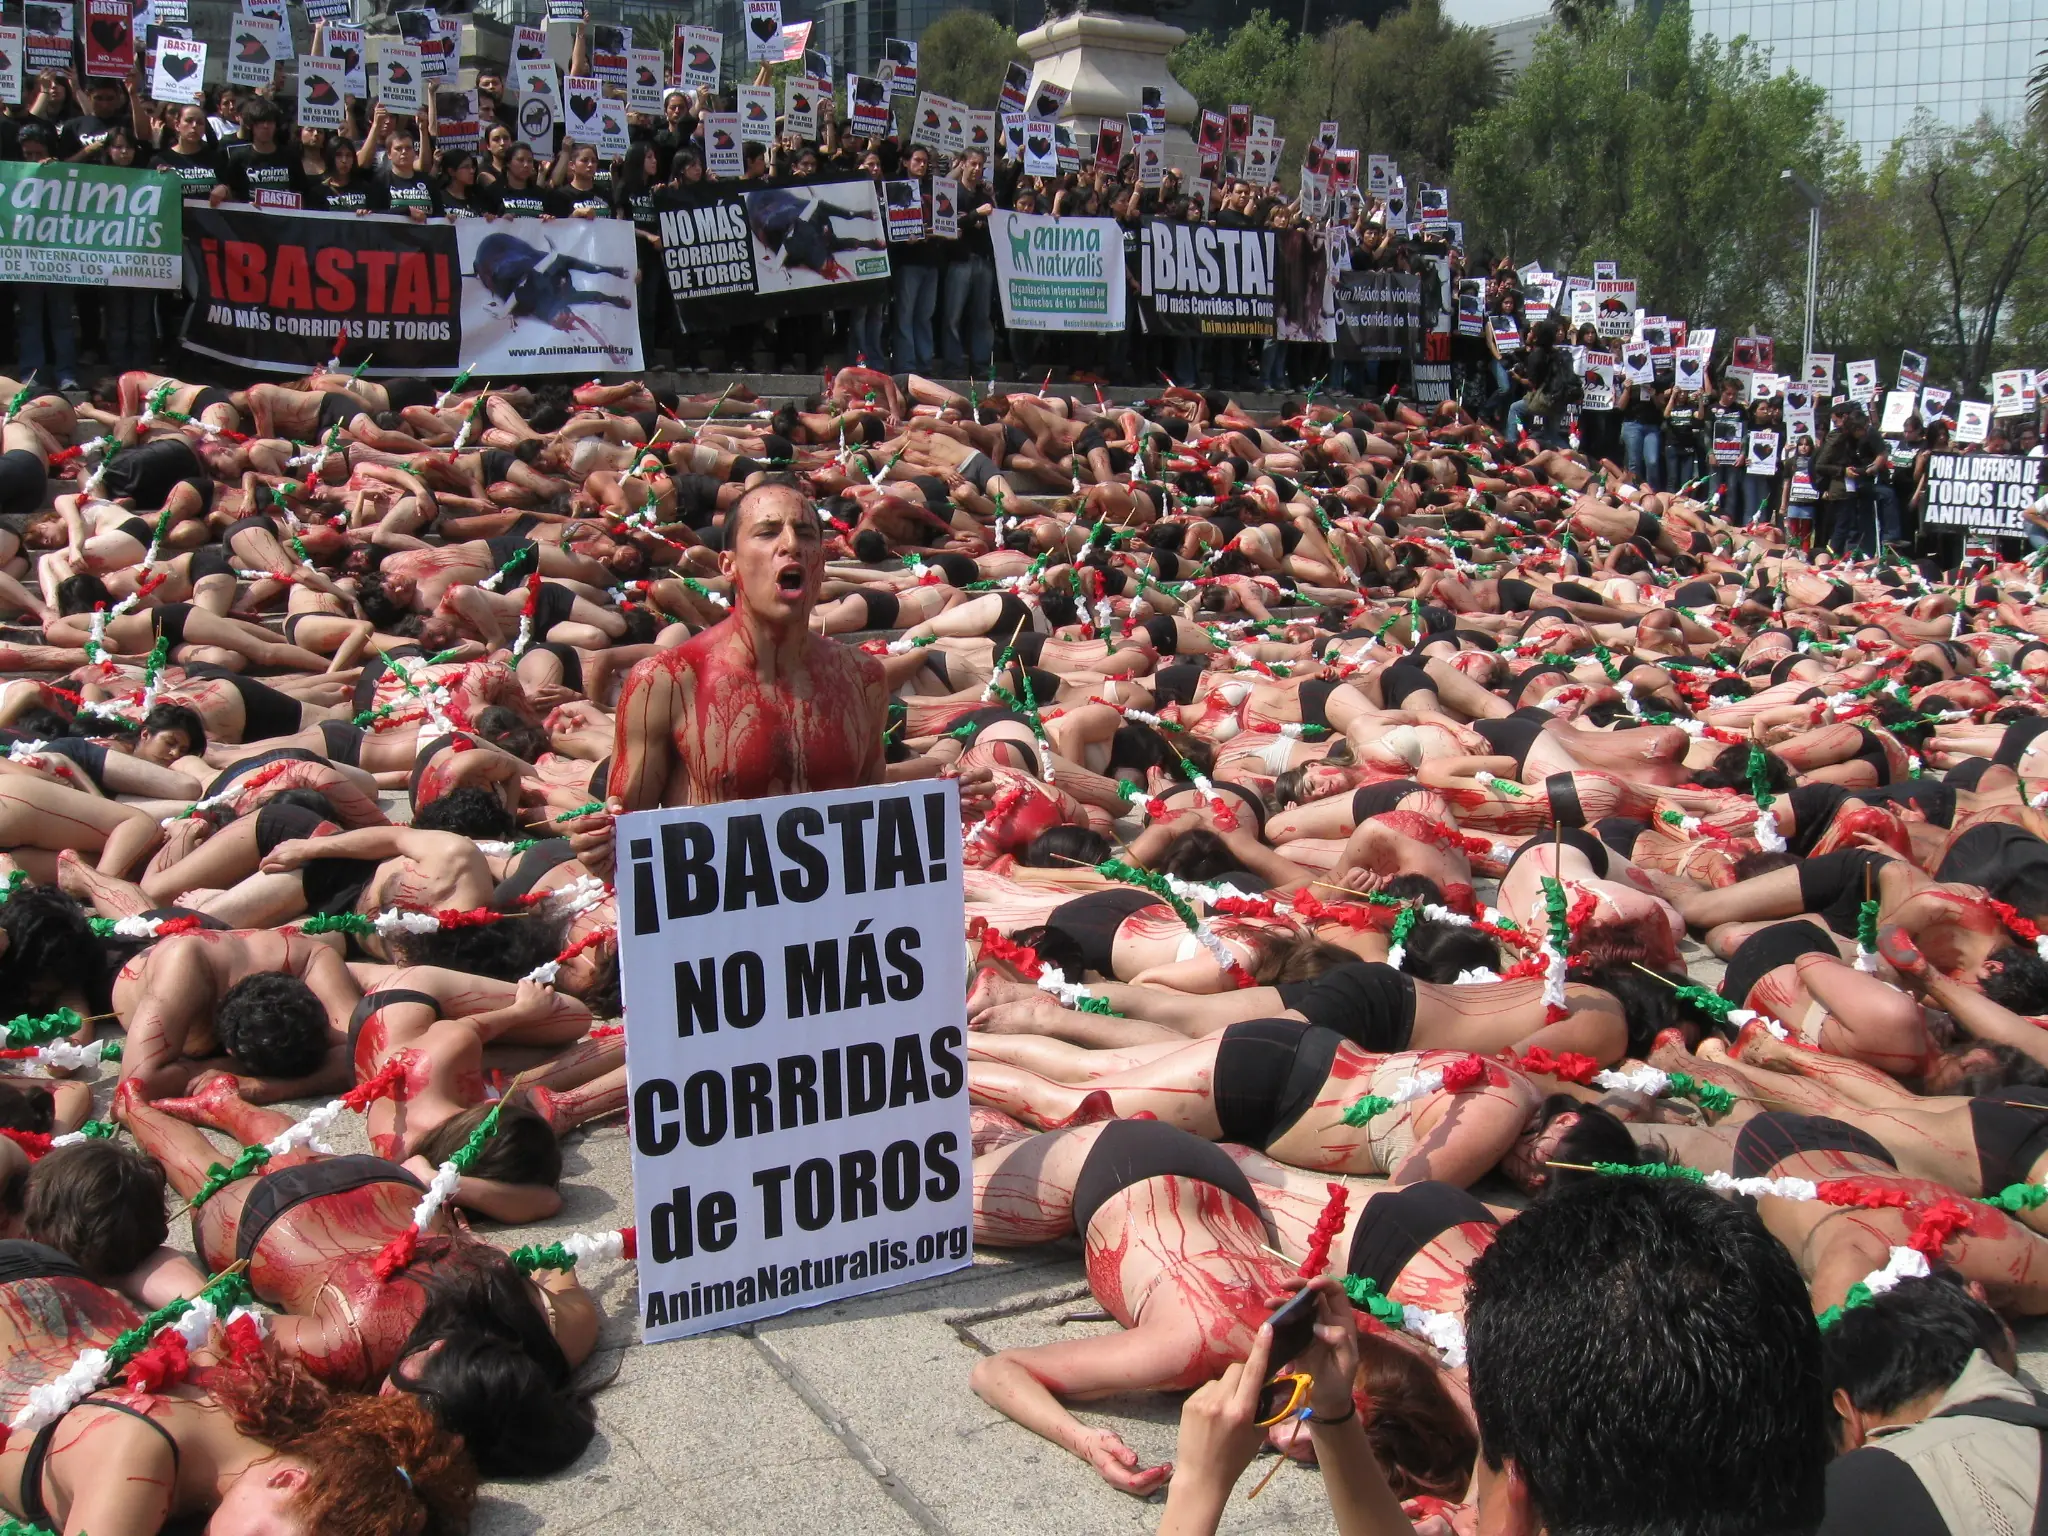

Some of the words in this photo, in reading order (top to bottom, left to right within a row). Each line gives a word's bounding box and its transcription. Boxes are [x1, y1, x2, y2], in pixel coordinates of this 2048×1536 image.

[90, 2, 127, 16] ¡BASTA!
[309, 6, 347, 18] ABOLICIÓN
[748, 1, 777, 14] ¡BASTA!
[244, 21, 274, 30] TORTURA
[329, 30, 359, 43] ¡BASTA!
[519, 29, 546, 43] ¡BASTA!
[695, 33, 719, 43] TORTURA
[163, 40, 201, 53] ¡BASTA!
[390, 49, 416, 57] TORTURA
[638, 54, 660, 62] TORTURA
[233, 65, 243, 73] NO
[252, 67, 270, 75] ARTE
[311, 61, 341, 71] TORTURA
[242, 73, 270, 82] CULTURA
[703, 75, 716, 83] ARTE
[568, 78, 598, 91] ¡BASTA!
[1042, 84, 1067, 97] ¡BASTA!
[392, 94, 416, 102] CULTURA
[303, 107, 312, 115] NO
[322, 108, 339, 116] ARTE
[312, 115, 341, 124] CULTURA
[795, 120, 813, 128] CULTURA
[853, 122, 885, 134] ABOLICIÓN
[1027, 123, 1052, 133] ¡BASTA!
[1337, 149, 1356, 157] ¡BASTA!
[11, 169, 163, 216] anima
[260, 191, 296, 206] ¡BASTA!
[517, 197, 544, 206] anima
[660, 209, 695, 248] NO
[693, 199, 747, 243] MÁS
[12, 213, 163, 248] naturalis
[892, 226, 922, 236] ABOLICIÓN
[1034, 225, 1100, 252] anima
[26, 249, 122, 264] INTERNACIONAL
[126, 255, 148, 265] POR
[152, 256, 172, 267] LOS
[665, 240, 749, 269] CORRIDAS
[1141, 221, 1275, 296] ¡BASTA!
[5, 261, 21, 271] DE
[31, 262, 71, 274] TODOS
[81, 265, 103, 275] LOS
[112, 267, 173, 279] ANIMALES
[1036, 253, 1103, 278] naturalis
[0, 272, 109, 286] www.AnimaNaturalis.org
[200, 237, 450, 315] ¡BASTA!
[668, 270, 698, 290] DE
[697, 261, 752, 285] TOROS
[1569, 278, 1590, 288] ¡BASTA!
[1596, 280, 1635, 293] TORTURA
[673, 283, 754, 300] www.AnimaNaturalis.org
[1052, 285, 1094, 296] Internacional
[1340, 292, 1351, 300] un
[1024, 297, 1053, 308] Derechos
[1055, 298, 1063, 308] de
[1066, 298, 1076, 308] los
[1079, 299, 1105, 309] Animales
[1156, 293, 1168, 313] NO
[1170, 296, 1190, 314] más
[1192, 296, 1235, 315] Corridas
[1236, 297, 1249, 316] De
[1251, 298, 1274, 317] Toros
[207, 304, 233, 325] NO
[234, 306, 270, 331] MÁS
[275, 316, 363, 339] CORRIDAS
[368, 320, 390, 340] DE
[395, 320, 450, 341] TOROS
[1394, 314, 1404, 327] de
[1611, 321, 1631, 329] ARTE
[508, 344, 634, 357] www.AnimaNaturalis.org
[1625, 342, 1646, 352] ¡BASTA!
[1679, 348, 1700, 356] ¡BASTA!
[1787, 383, 1809, 391] ¡BASTA!
[1753, 432, 1777, 440] ¡BASTA!
[1929, 455, 1954, 479] POR
[1955, 457, 1970, 481] LA
[1971, 458, 2021, 483] DEFENSA
[2022, 461, 2041, 484] DE
[1928, 479, 1993, 507] TODOS
[1997, 484, 2034, 509] LOS
[1924, 505, 2024, 528] ANIMALES
[630, 792, 948, 936] ¡BASTA!
[674, 950, 766, 1038] NO
[784, 918, 924, 1019] MÁS
[634, 1029, 964, 1157] CORRIDAS
[651, 1185, 738, 1264] de
[752, 1131, 960, 1240] TOROS
[645, 1225, 968, 1329] AnimaNaturalis.org
